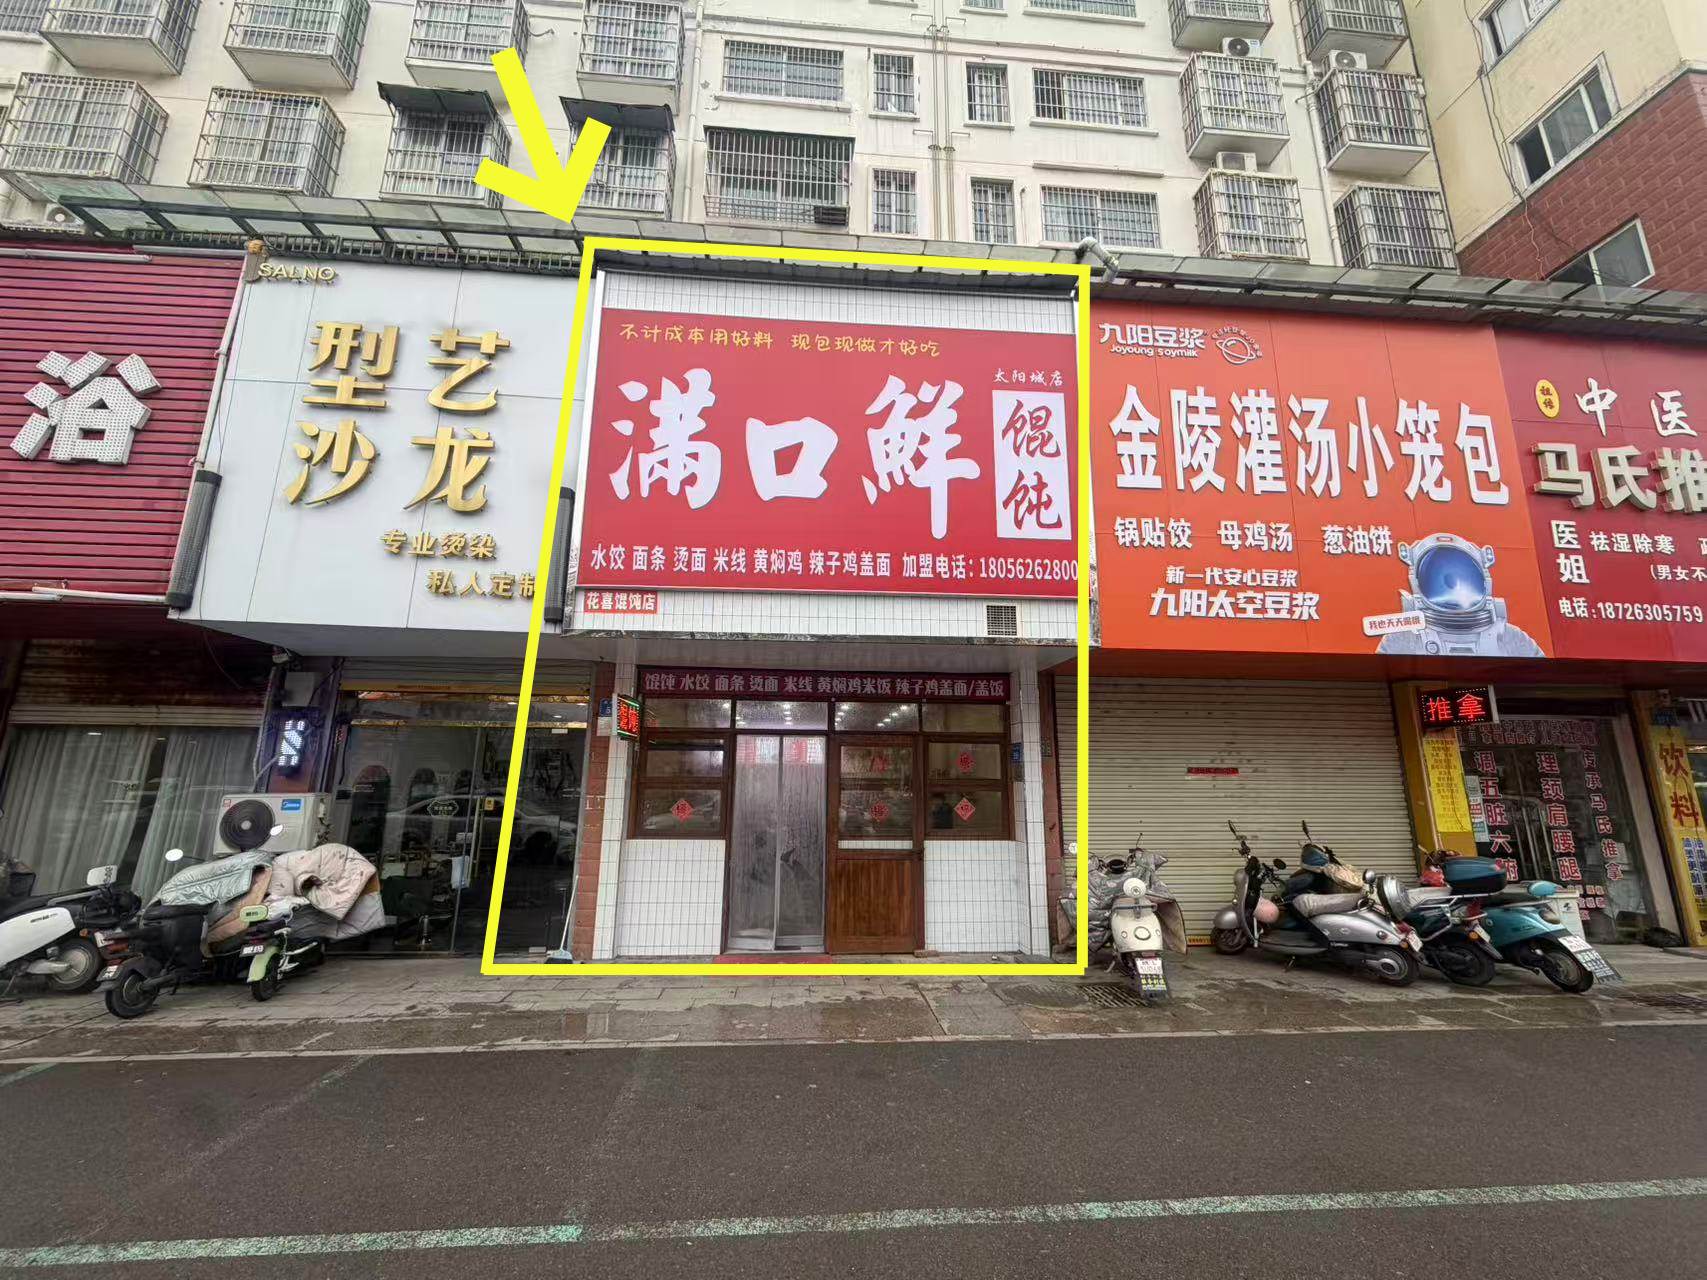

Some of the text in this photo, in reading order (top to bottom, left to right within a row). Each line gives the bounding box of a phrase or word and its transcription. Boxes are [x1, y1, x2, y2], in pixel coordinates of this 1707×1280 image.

[258, 262, 336, 281] SALNO
[620, 323, 941, 357] 不计成本用好料 现包现做才好吃
[1099, 322, 1206, 349] 九阳豆浆
[300, 319, 511, 413] 型艺
[993, 368, 1064, 387] 太阳城店
[9, 350, 162, 465] 浴
[1575, 377, 1698, 438] 中医
[1109, 383, 1509, 505] 金陵灌汤小笼包
[283, 418, 497, 513] 沙龙
[1001, 398, 1064, 531] 馄饨
[382, 529, 497, 560] 专业烫染
[1113, 516, 1394, 556] 锅贴饺 母鸡汤 葱油饼
[1589, 531, 1676, 555] 祛湿除寒
[590, 543, 626, 571] 水饺
[632, 545, 666, 572] 面条
[673, 546, 707, 573] 烫面
[713, 547, 747, 574] 米线
[753, 548, 803, 575] 黄焖鸡
[808, 550, 891, 577] 辣子鸡盖面
[1165, 565, 1299, 588] 新一代安心豆浆
[586, 591, 656, 611] 花喜馄饨店
[1149, 587, 1320, 620] 九阳太空豆浆
[645, 673, 1004, 697] 馄饨 水饺 面条 烫面 米线 黄焖鸡米饭 辣子鸡盖面/盖饭
[1426, 692, 1487, 722] 推拿
[1659, 742, 1700, 827] 饮料
[1536, 751, 1583, 881] 理颈肩腰腿
